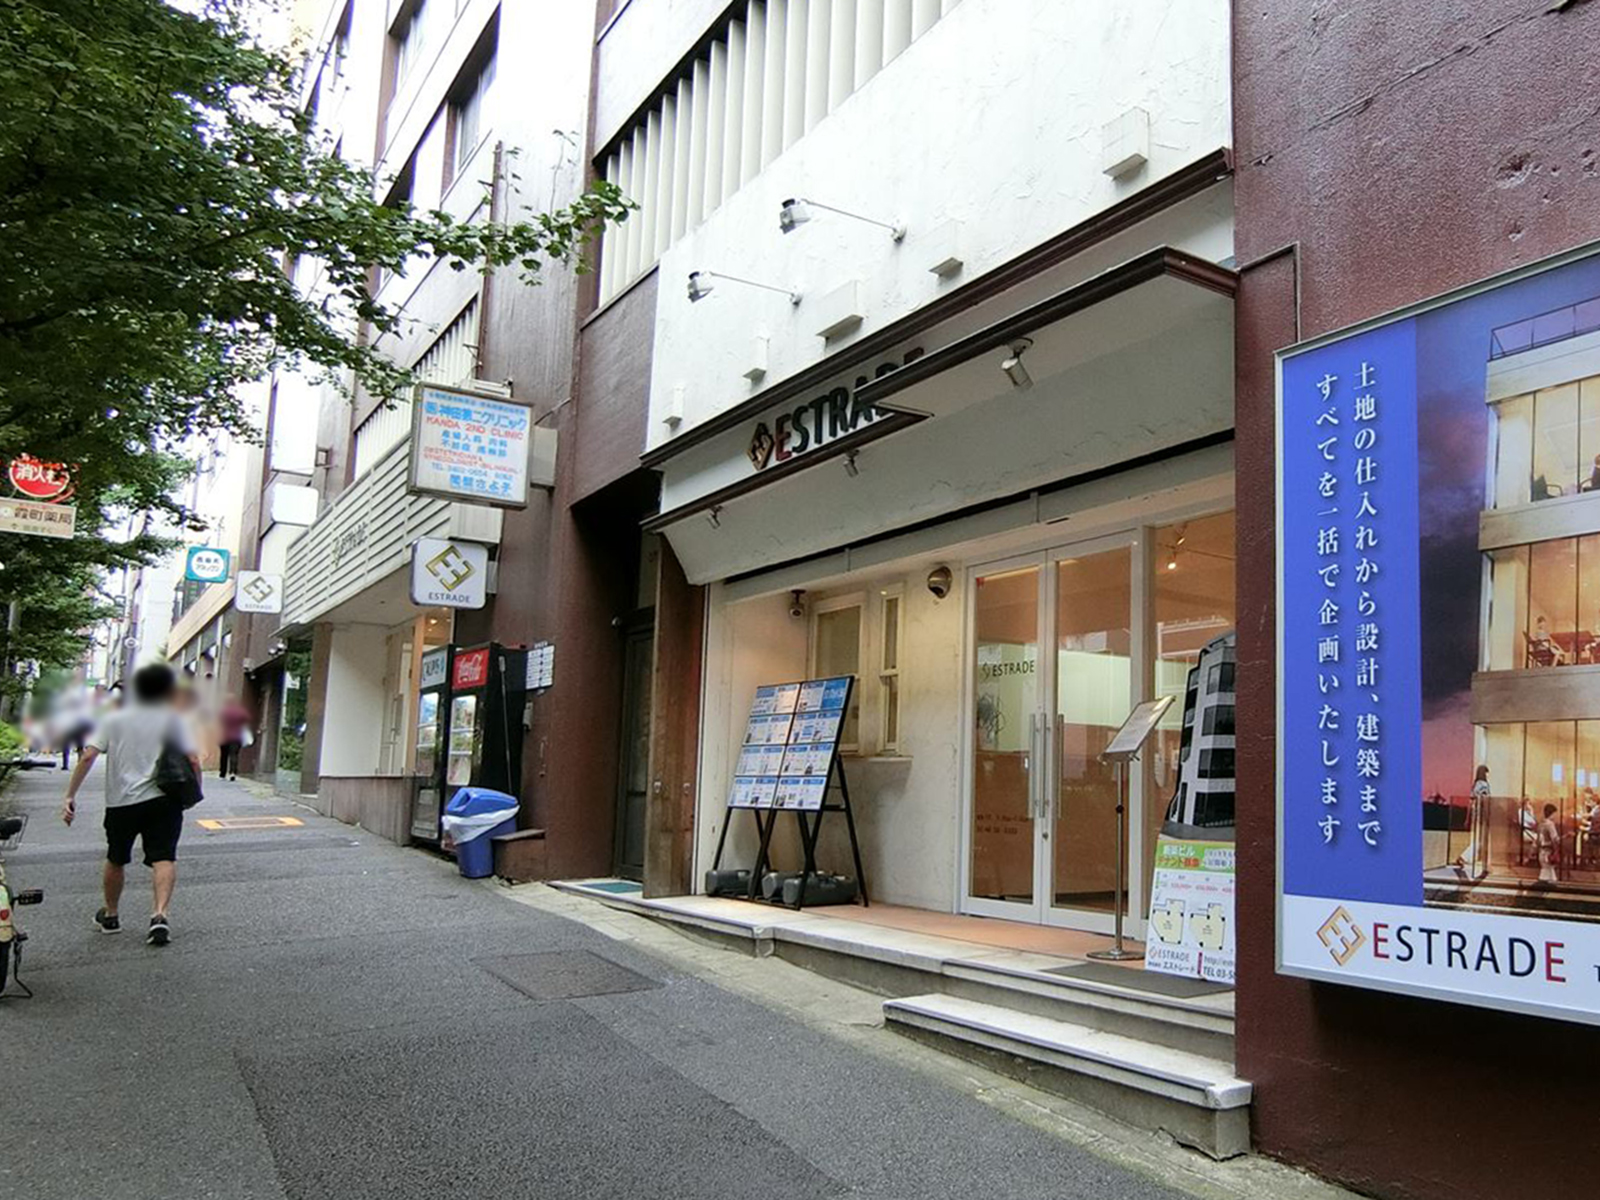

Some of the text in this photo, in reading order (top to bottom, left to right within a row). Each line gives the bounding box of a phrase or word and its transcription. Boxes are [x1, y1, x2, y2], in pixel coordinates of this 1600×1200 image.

[426, 416, 524, 440] KANDA 2ND CLINIC
[429, 592, 471, 603] ESTRADE
[1316, 374, 1340, 843] すべてを一括で企画いたします
[1353, 362, 1381, 845] 土地の仕入れから設計、建築まで
[992, 660, 1035, 677] ESTRADE
[1158, 949, 1190, 962] ESTRADE
[1372, 923, 1567, 983] ESTRADE
